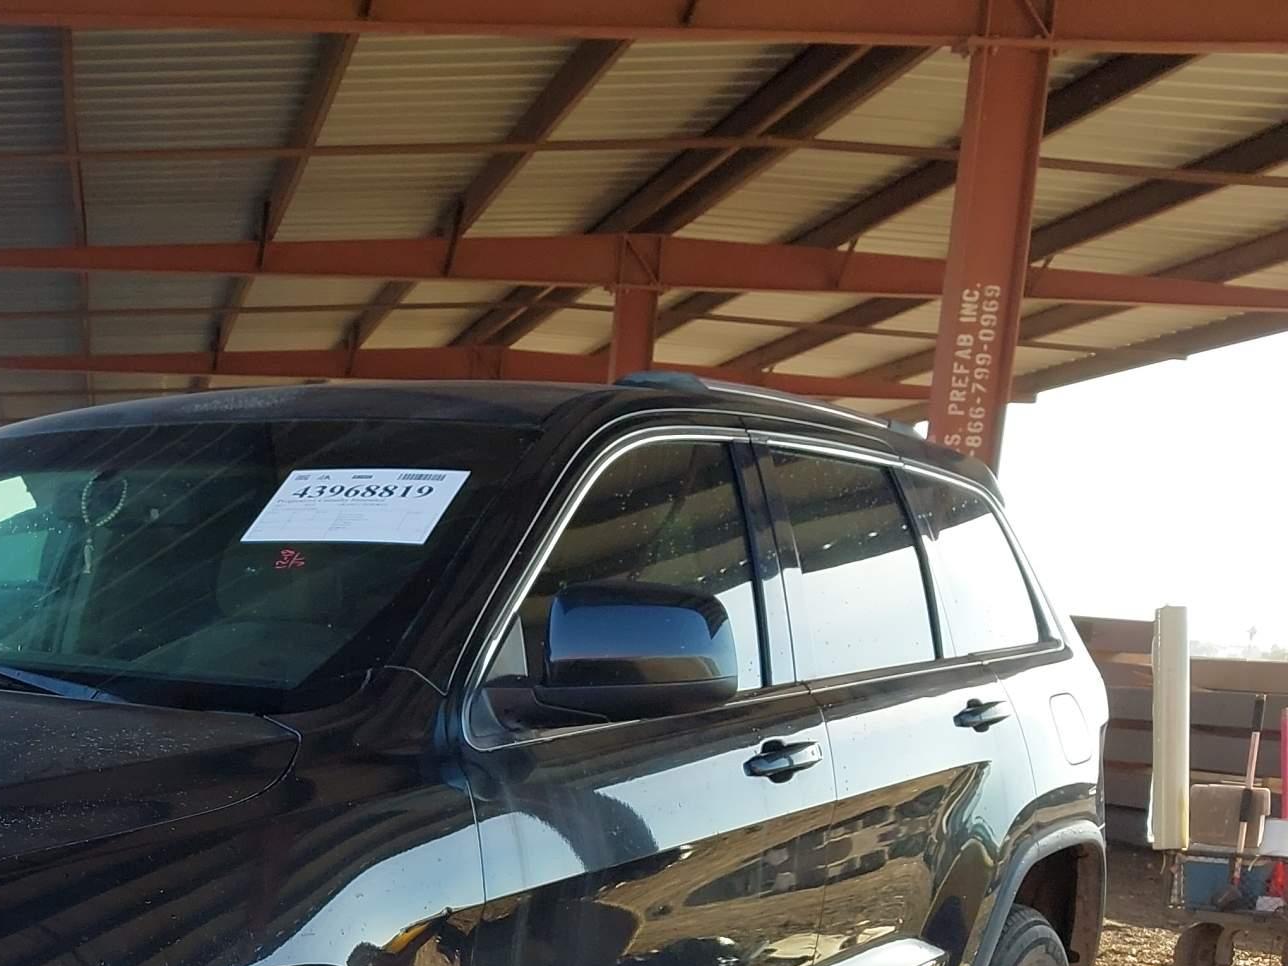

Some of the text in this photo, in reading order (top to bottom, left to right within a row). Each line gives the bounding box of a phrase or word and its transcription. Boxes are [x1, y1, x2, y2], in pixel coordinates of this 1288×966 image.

[944, 282, 982, 453] .S. PREFAB INC.
[965, 285, 1001, 457] -866-799-0969
[293, 484, 434, 499] 43968819
